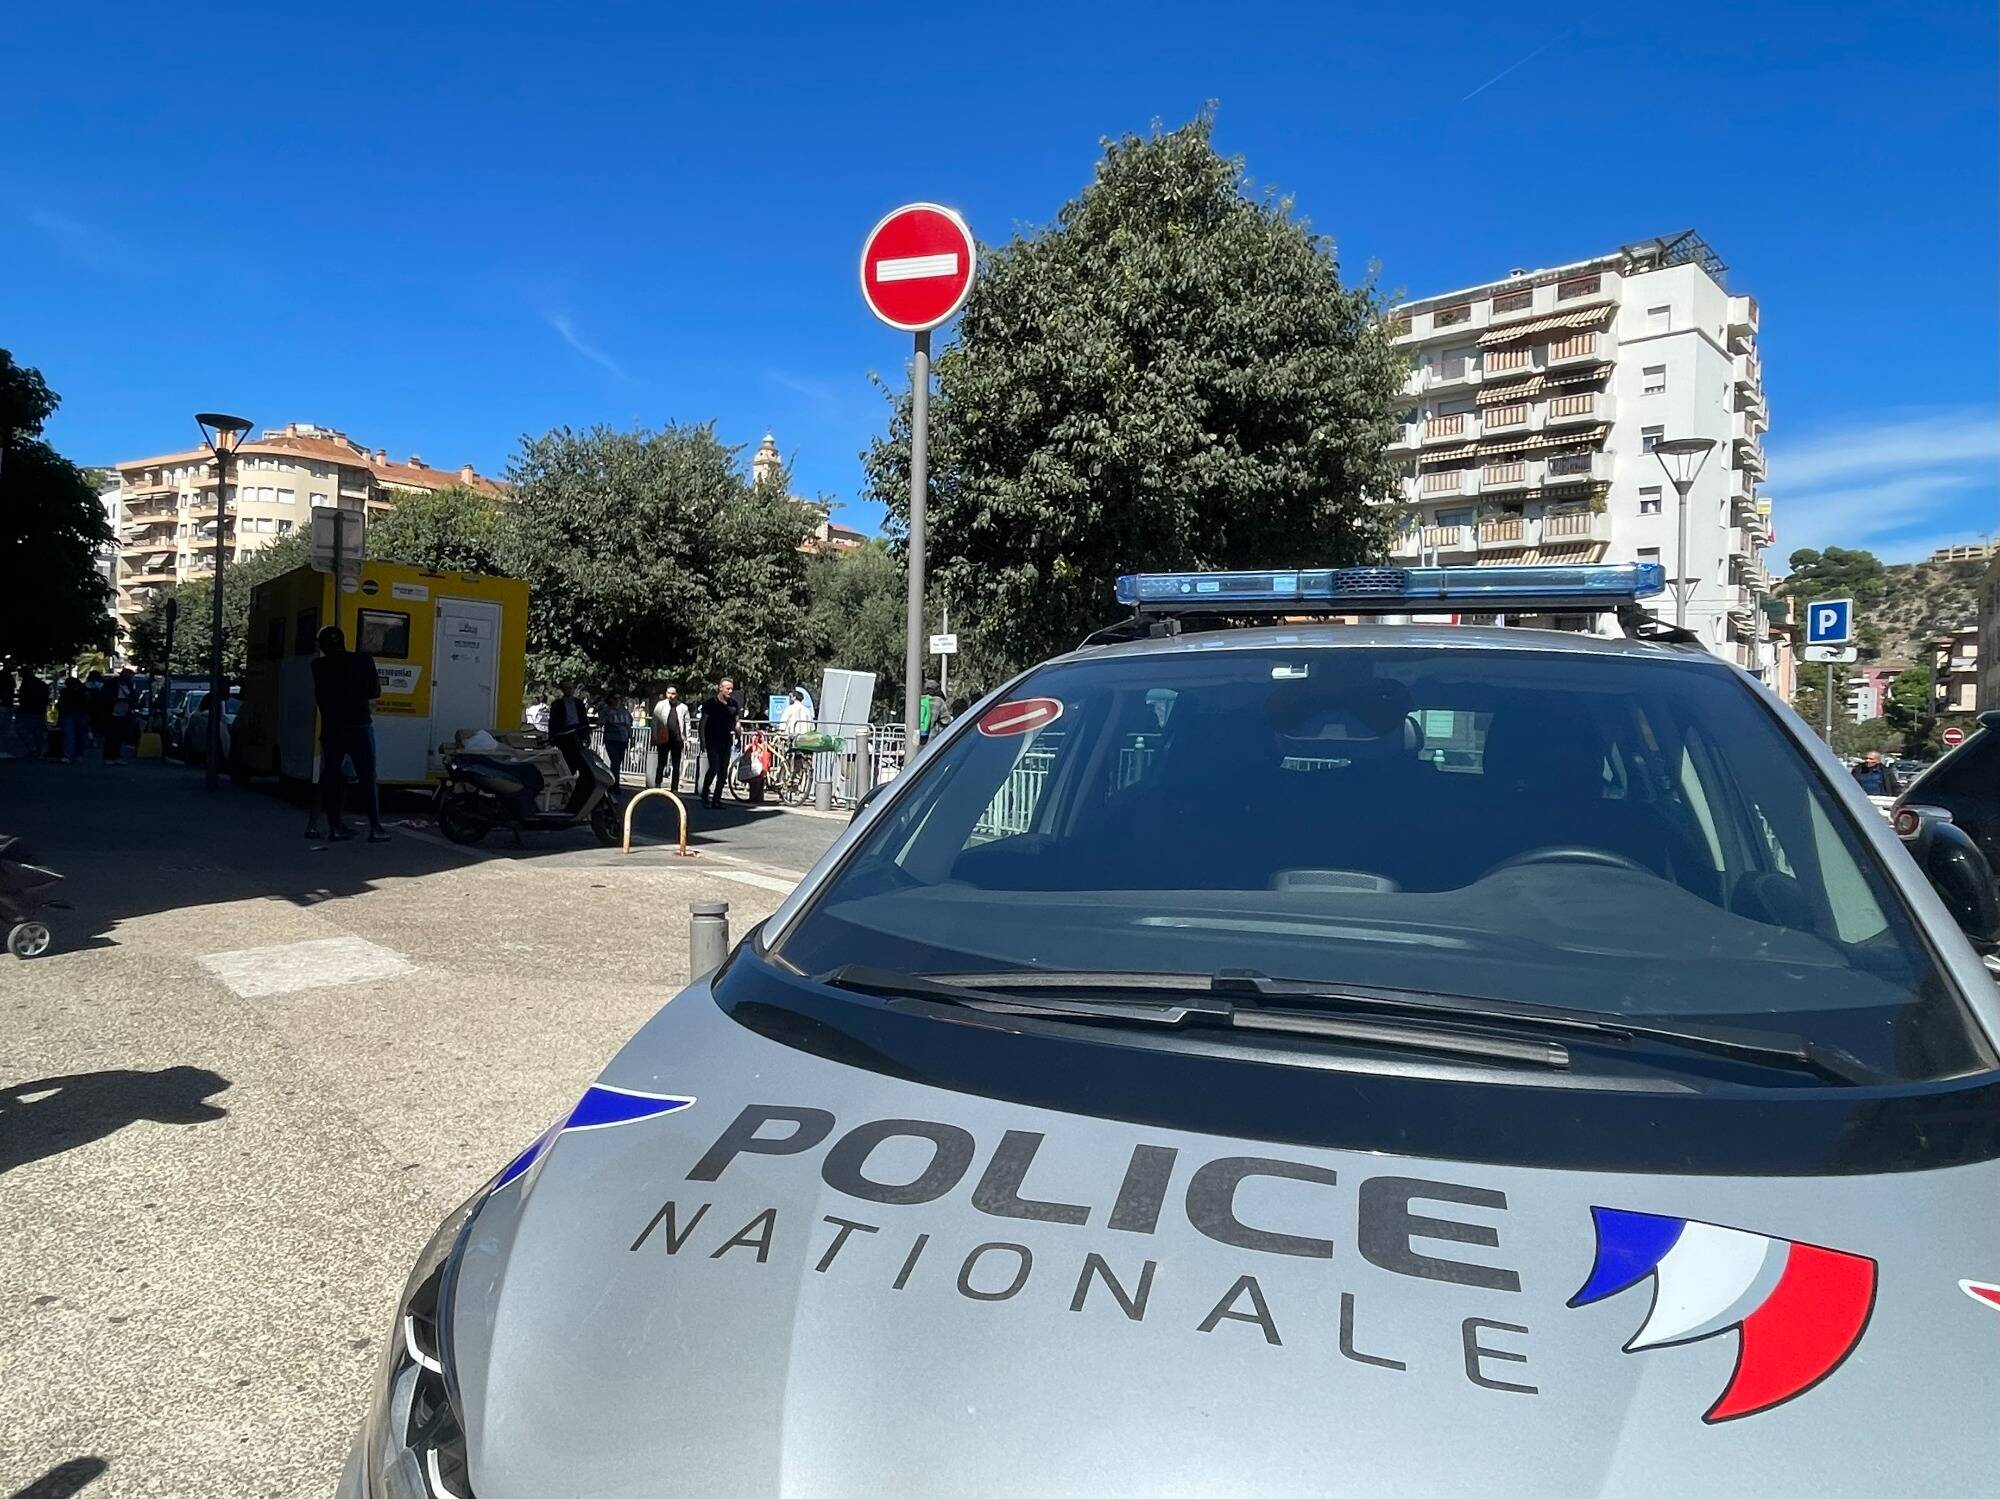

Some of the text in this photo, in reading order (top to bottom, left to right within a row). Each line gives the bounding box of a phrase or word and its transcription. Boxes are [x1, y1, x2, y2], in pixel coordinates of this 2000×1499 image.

[1819, 609, 1838, 635] P
[685, 1103, 1522, 1293] POLICE
[630, 1200, 1540, 1395] NATIONALE
